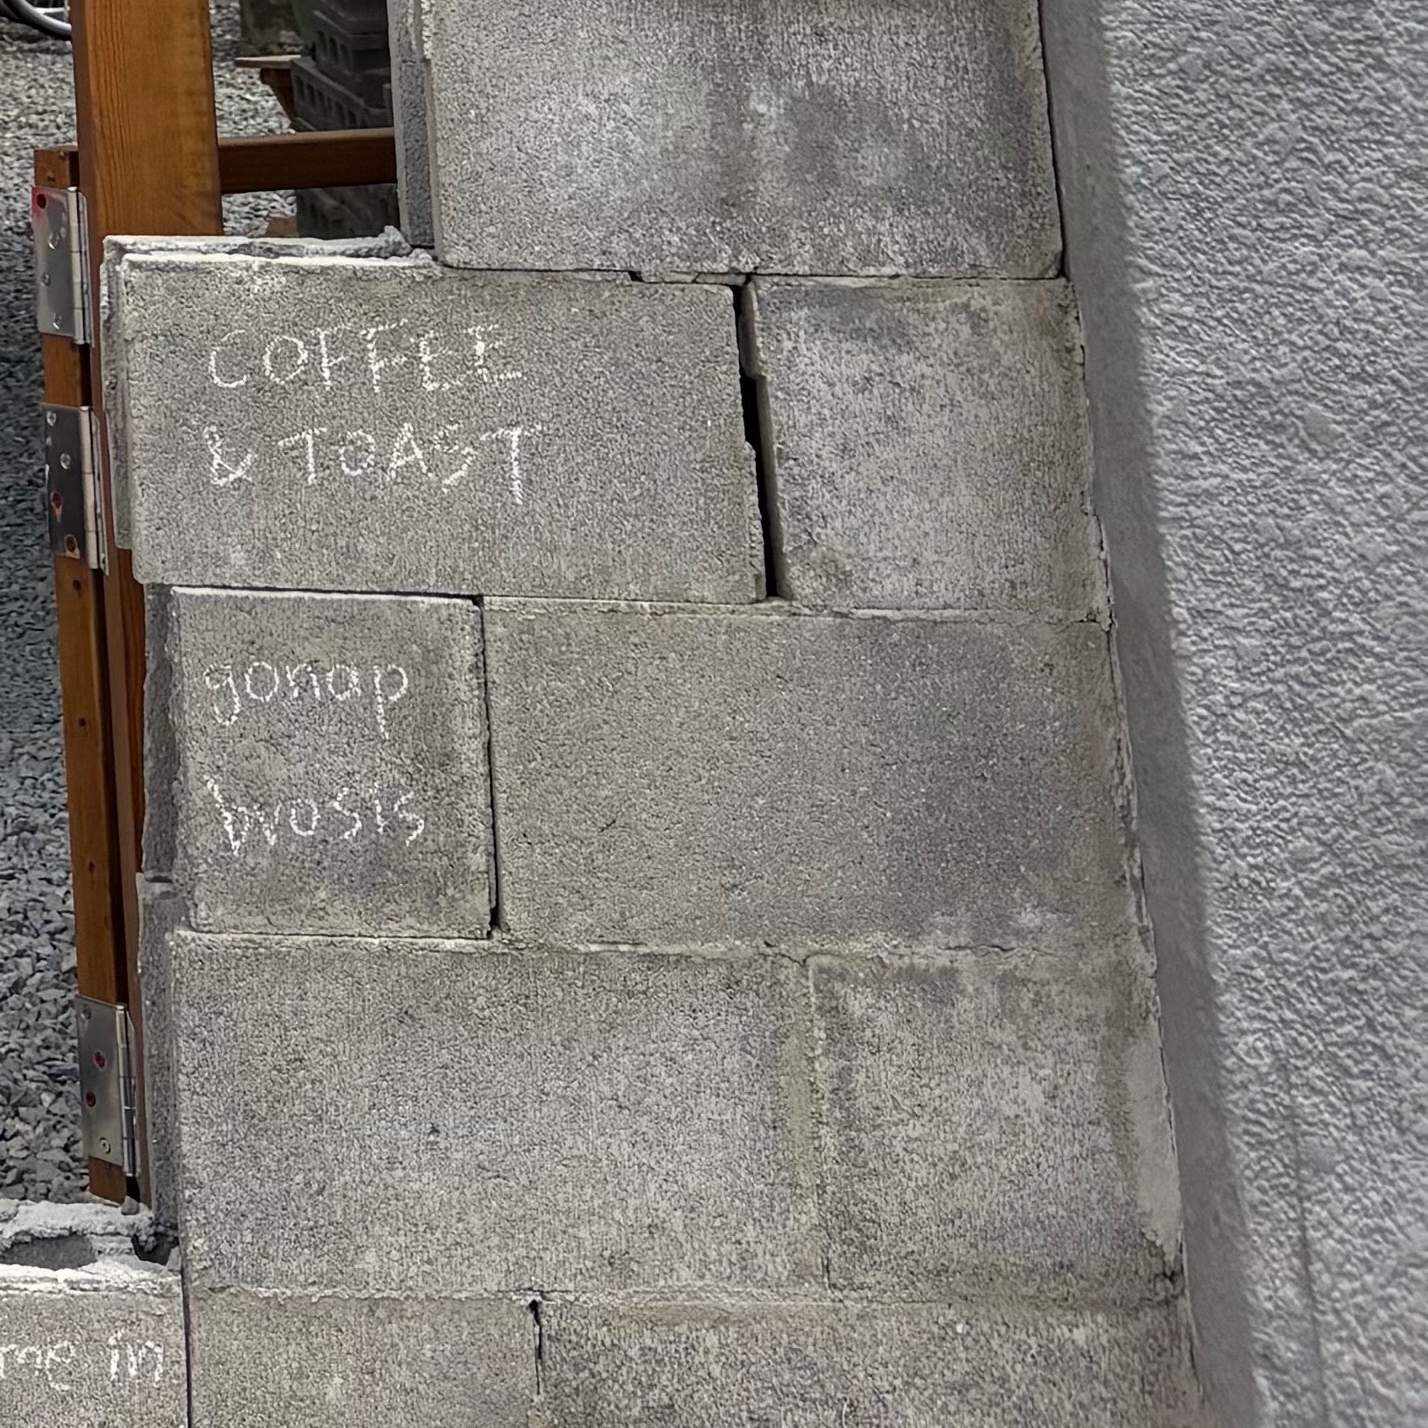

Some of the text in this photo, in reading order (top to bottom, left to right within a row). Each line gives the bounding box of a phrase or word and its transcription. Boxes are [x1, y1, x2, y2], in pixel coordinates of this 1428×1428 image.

[210, 318, 526, 392] COFFEE
[203, 422, 542, 505] & TOAST
[203, 661, 408, 740] gonap
